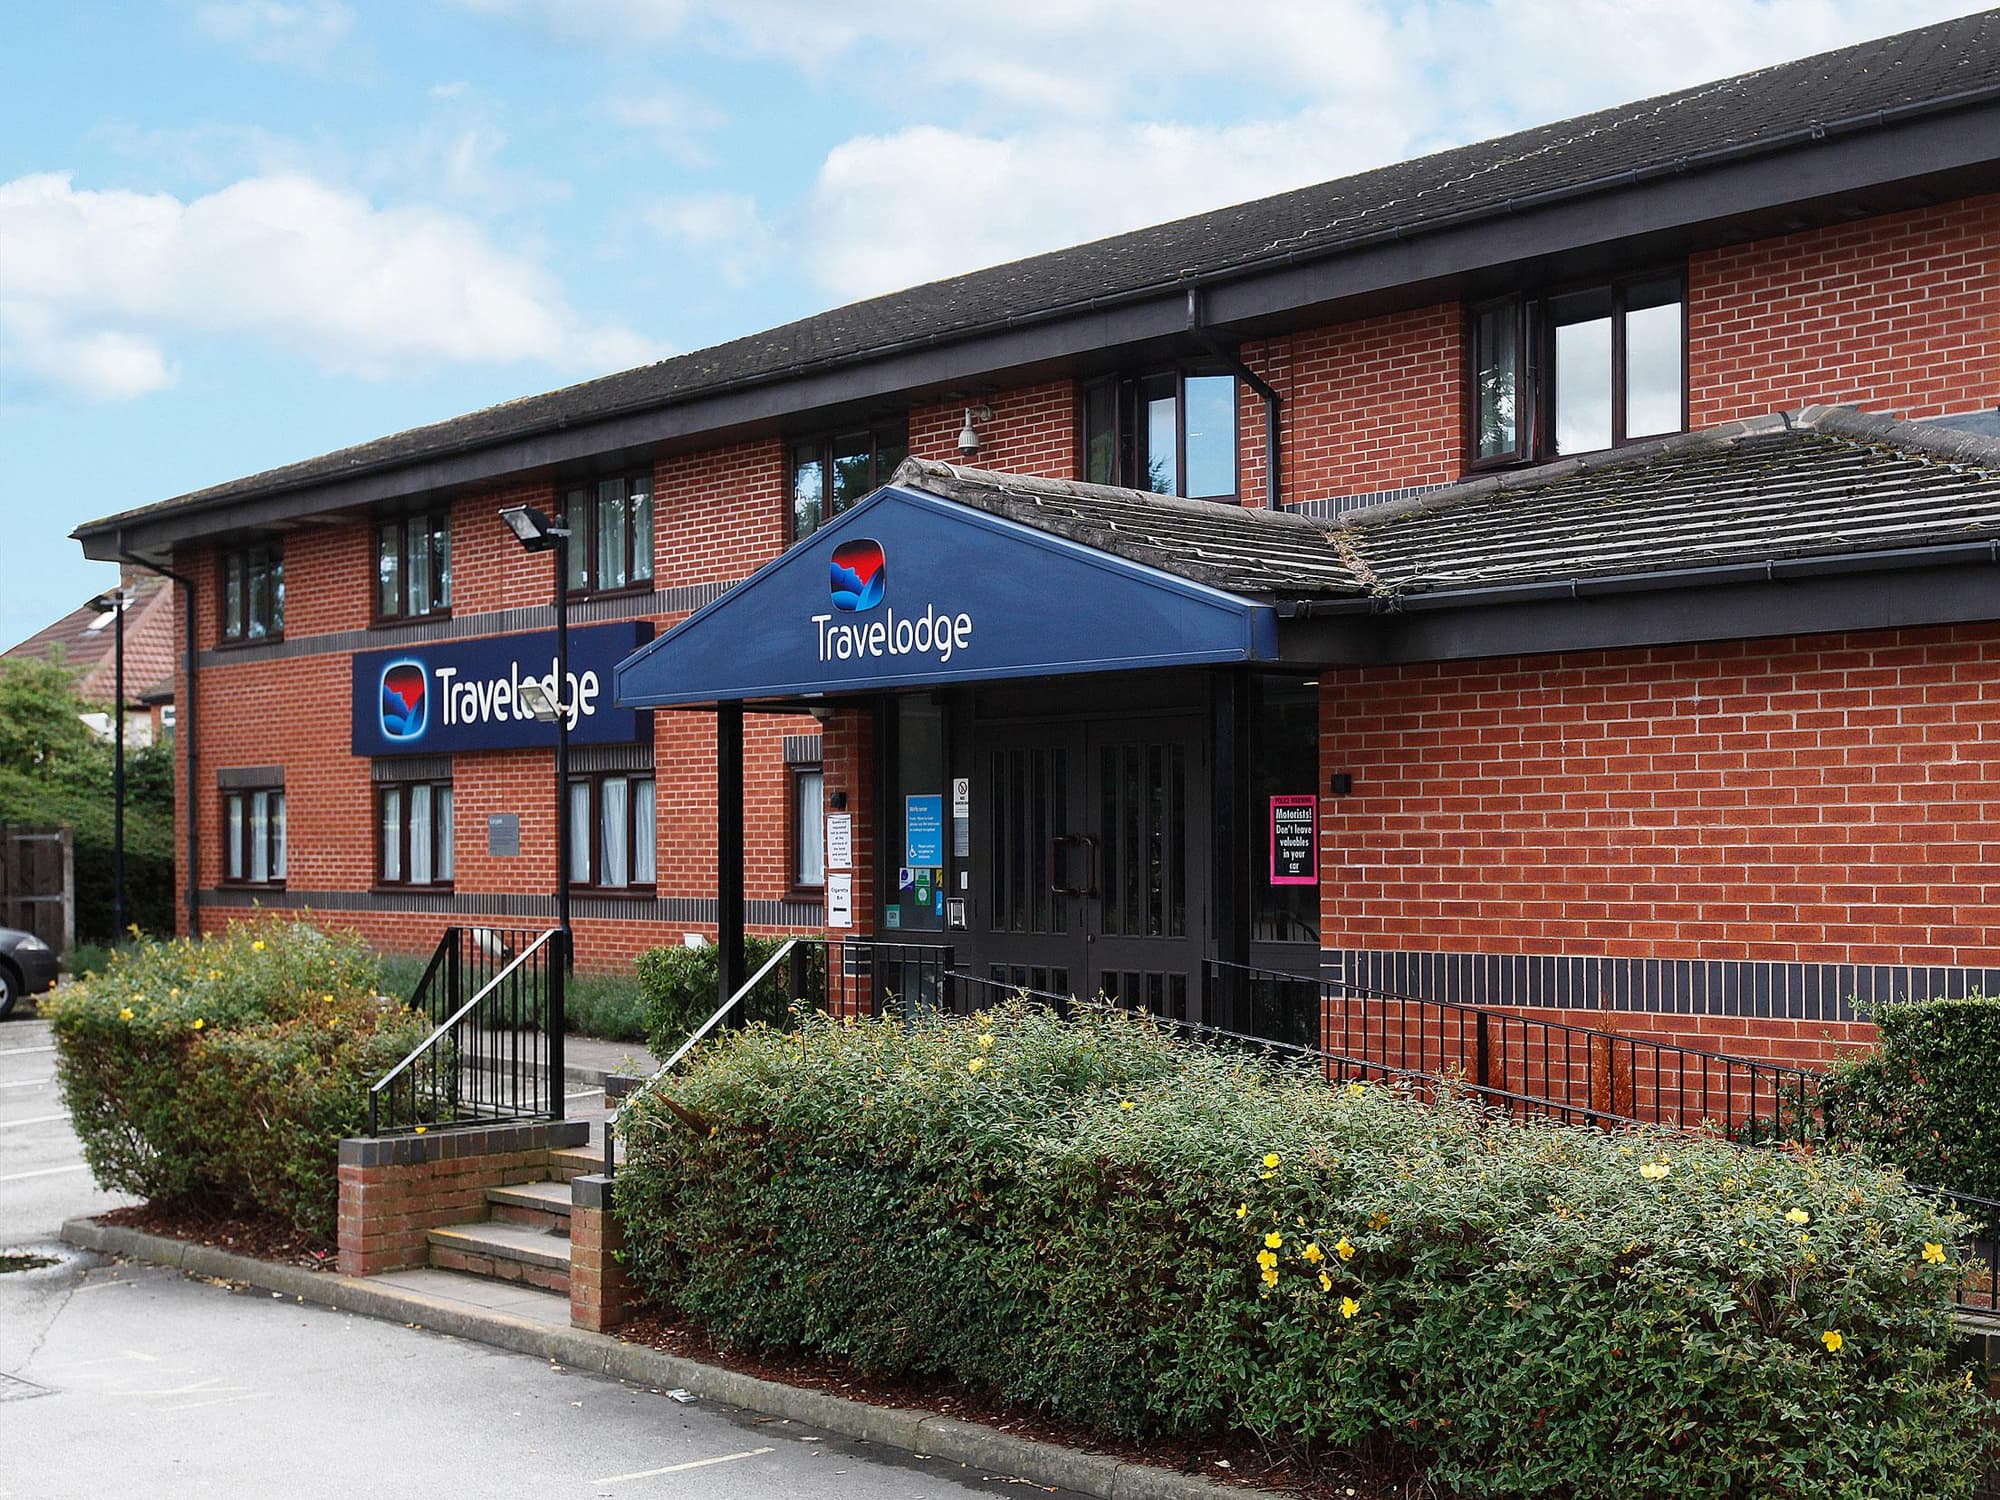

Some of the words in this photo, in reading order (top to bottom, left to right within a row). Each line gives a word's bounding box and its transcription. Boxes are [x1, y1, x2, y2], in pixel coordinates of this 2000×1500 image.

[811, 603, 973, 662] Travelodge
[1276, 808, 1312, 819] Motorists!
[1276, 824, 1292, 834] Don't
[1295, 824, 1312, 834] leave
[1280, 836, 1309, 846] valuables
[1283, 848, 1290, 858] in
[1290, 851, 1305, 861] your
[1289, 862, 1299, 870] car
